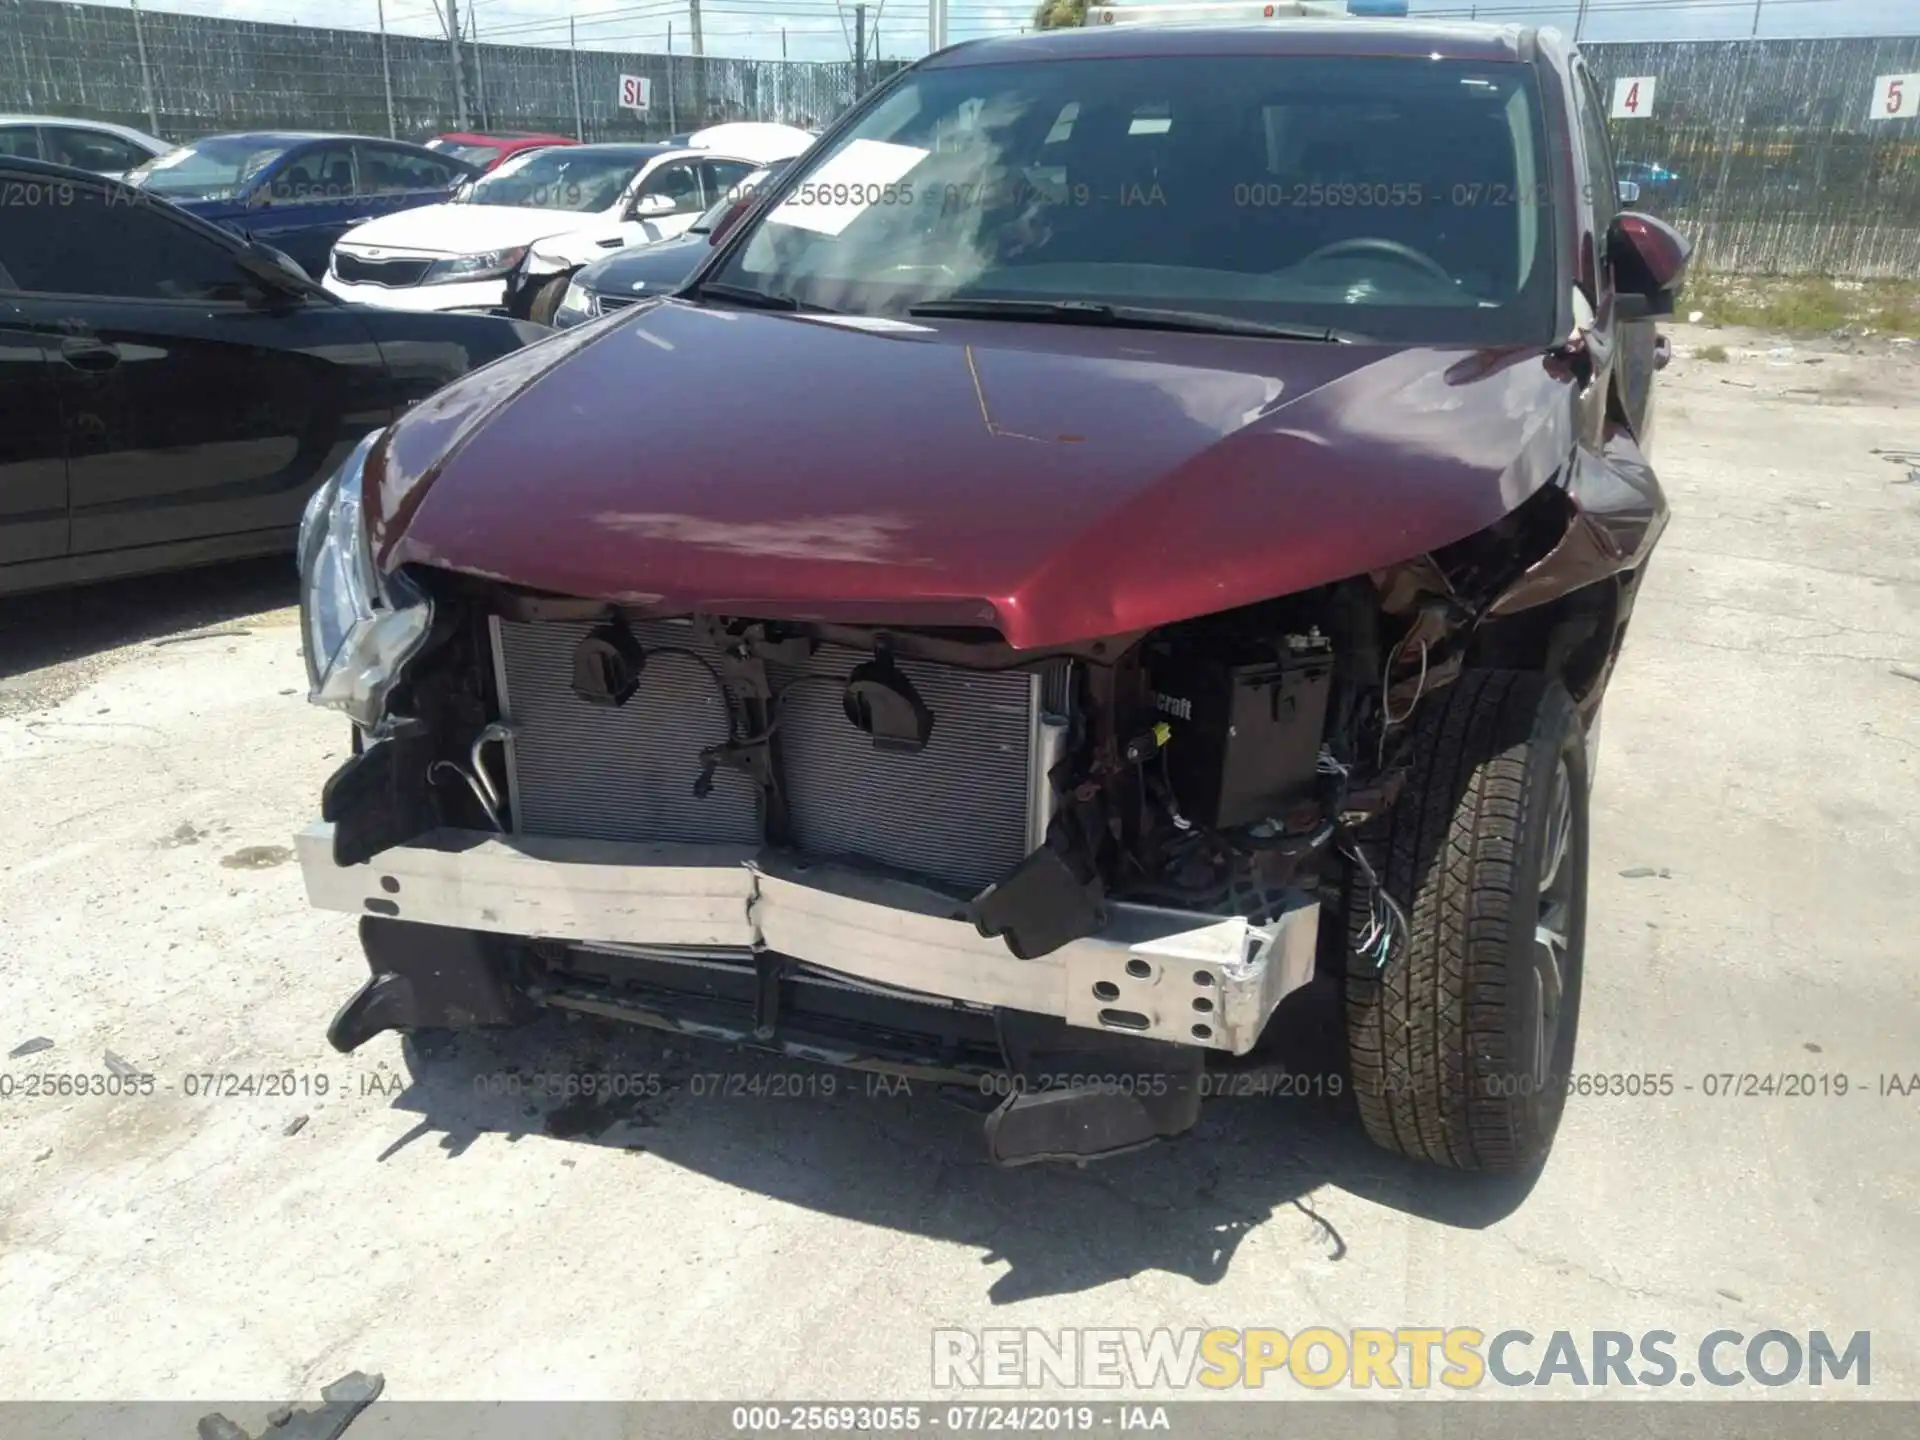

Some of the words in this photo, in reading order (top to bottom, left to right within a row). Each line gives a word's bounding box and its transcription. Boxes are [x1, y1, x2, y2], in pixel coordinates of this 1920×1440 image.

[623, 79, 646, 106] SL
[1624, 81, 1640, 113] 4
[1886, 79, 1904, 114] 5
